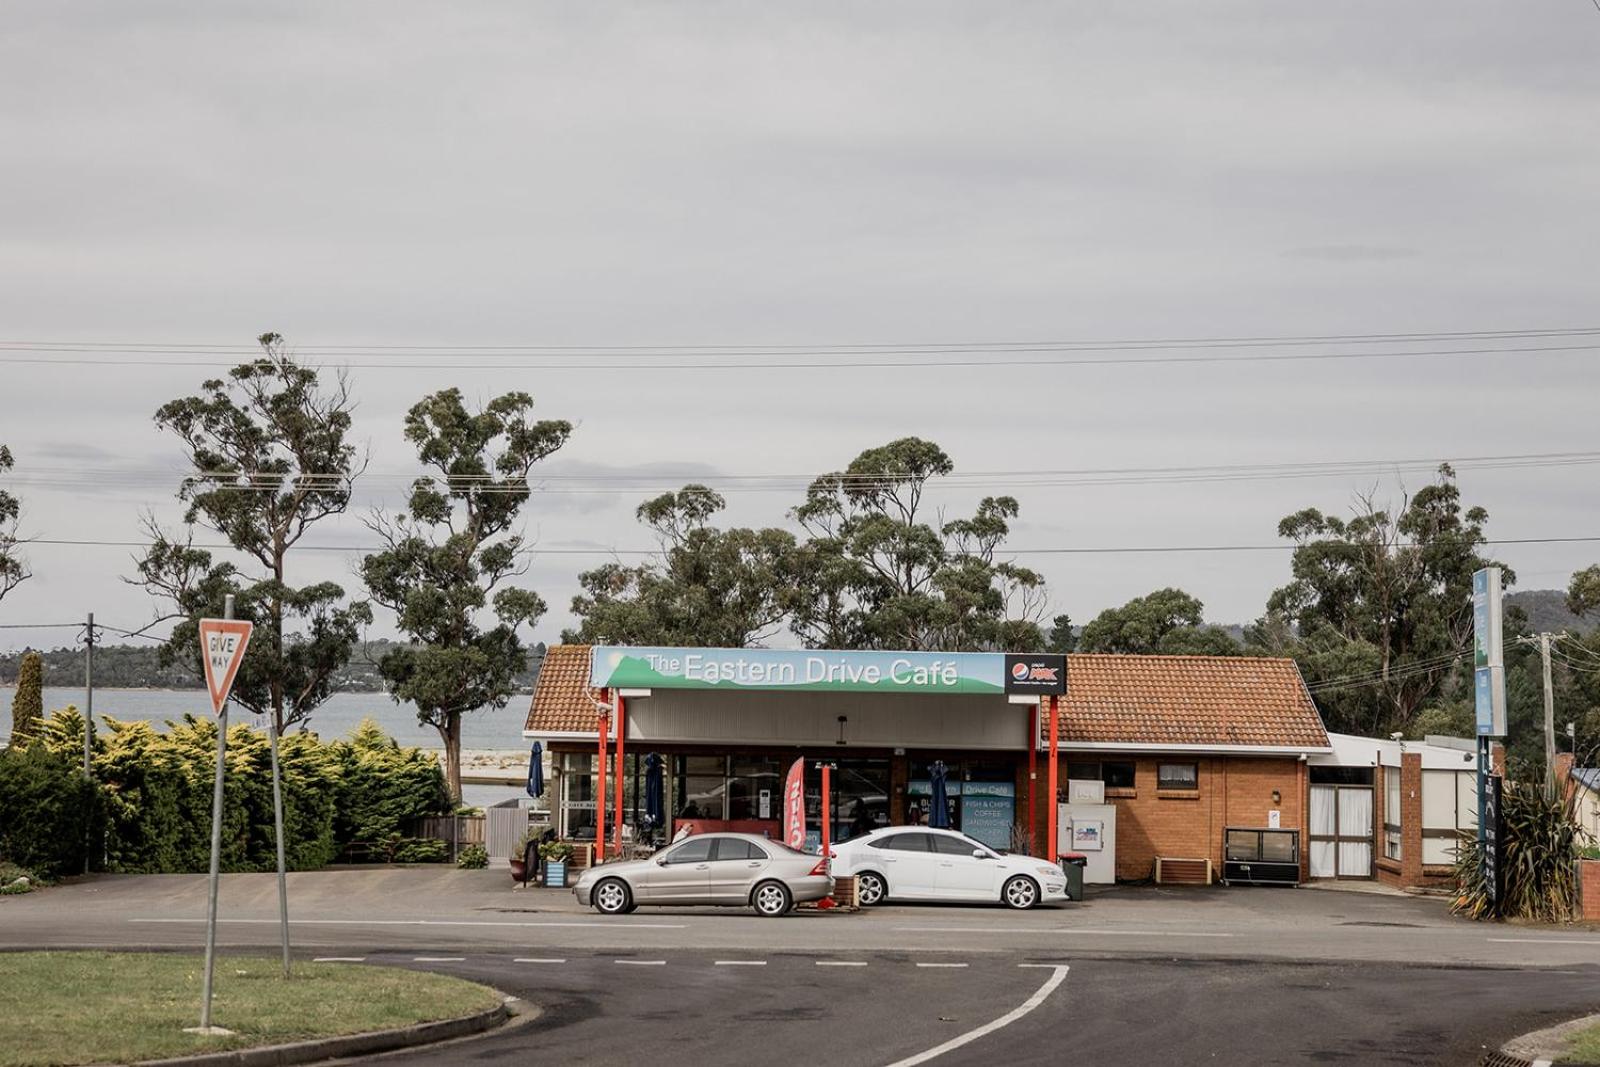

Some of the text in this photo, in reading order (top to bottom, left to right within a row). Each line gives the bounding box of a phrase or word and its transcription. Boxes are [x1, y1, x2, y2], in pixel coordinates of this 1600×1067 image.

[210, 637, 235, 653] GIVE
[212, 657, 229, 668] WAY
[648, 654, 958, 686] The Eastern Drive Café
